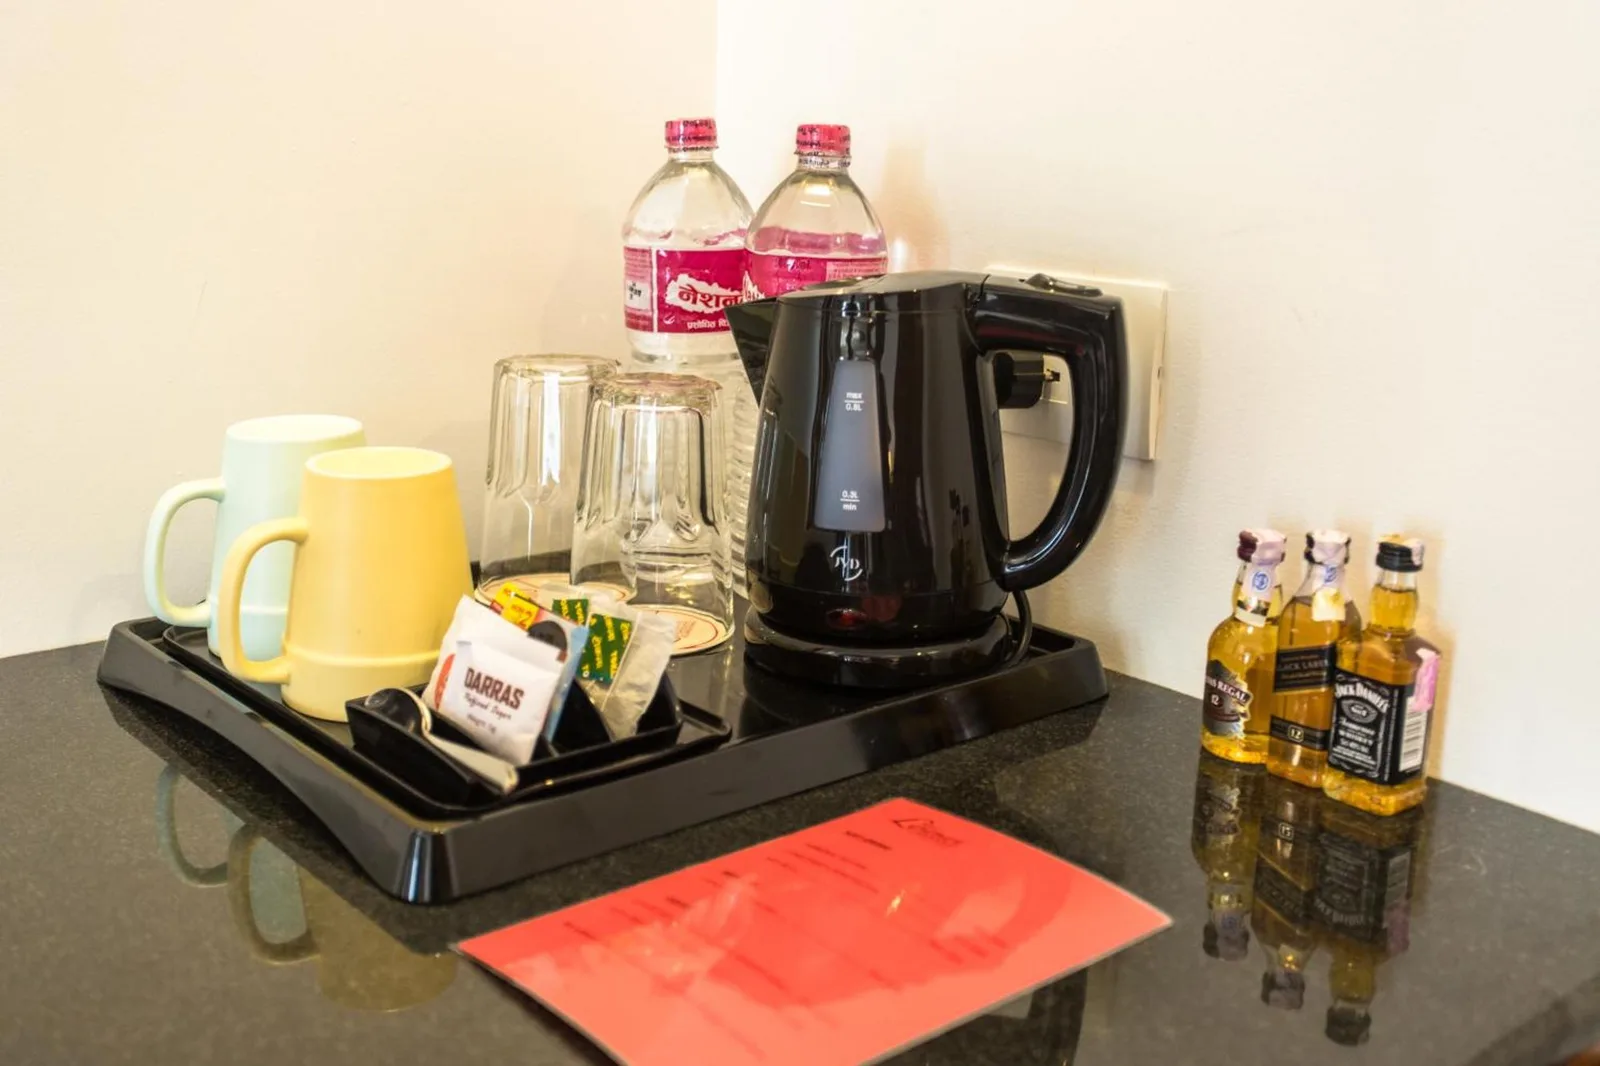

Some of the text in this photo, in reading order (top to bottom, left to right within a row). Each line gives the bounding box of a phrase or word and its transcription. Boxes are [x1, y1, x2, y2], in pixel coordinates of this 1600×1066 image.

[846, 391, 862, 400] max
[842, 501, 857, 511] min
[464, 667, 525, 710] DARRAS
[1217, 681, 1247, 702] REGAL
[1290, 728, 1302, 740] 12
